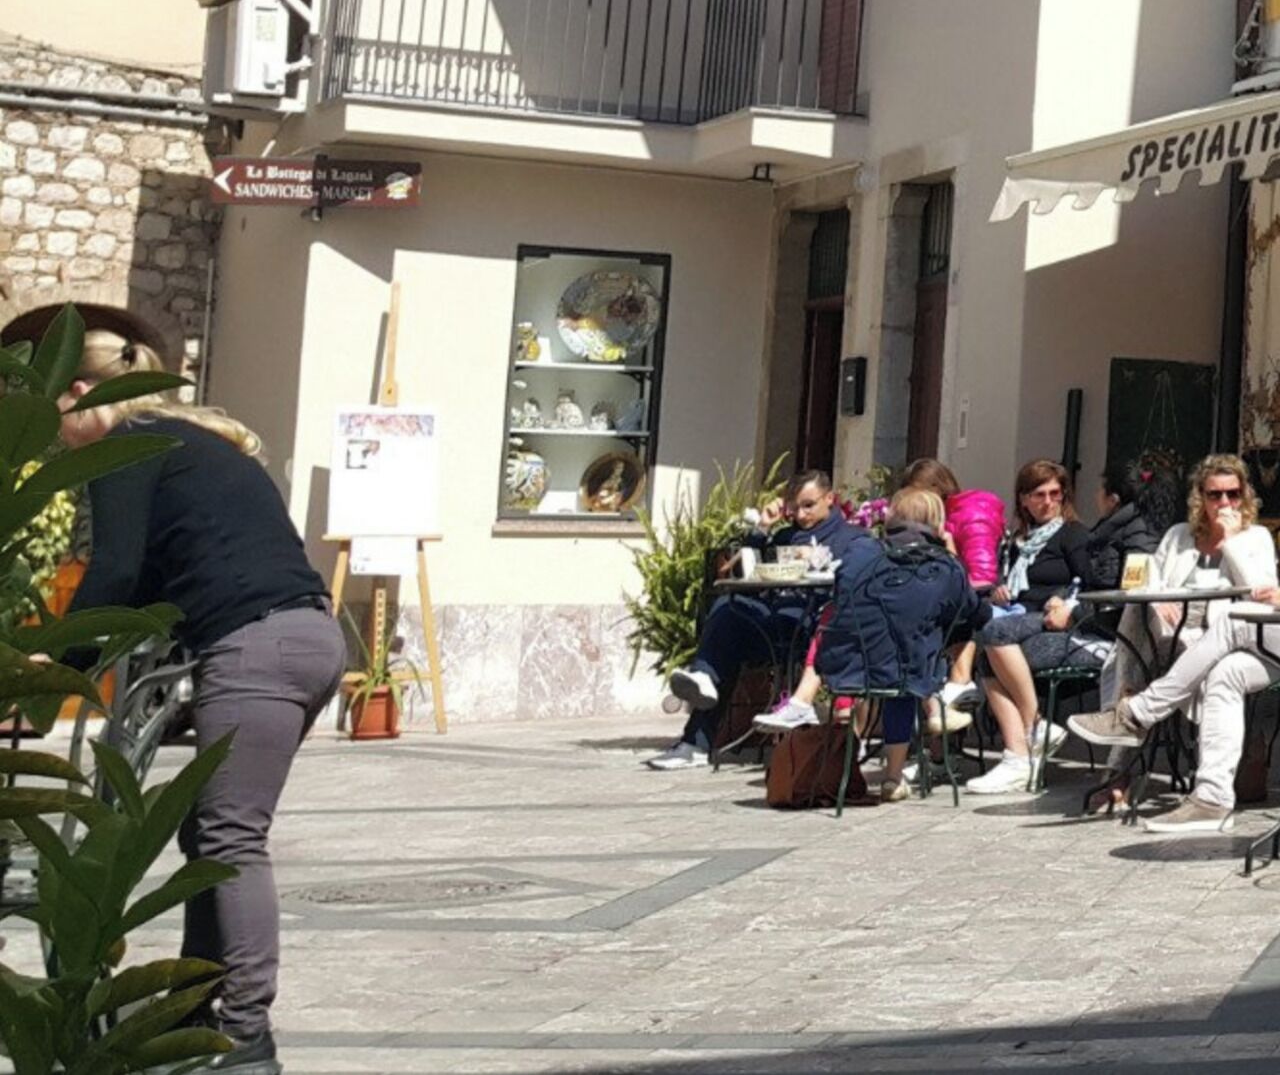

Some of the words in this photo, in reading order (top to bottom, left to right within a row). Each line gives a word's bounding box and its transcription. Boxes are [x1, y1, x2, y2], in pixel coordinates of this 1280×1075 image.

[246, 165, 263, 178] La
[266, 165, 313, 183] Bottega
[321, 186, 374, 201] MARKET
